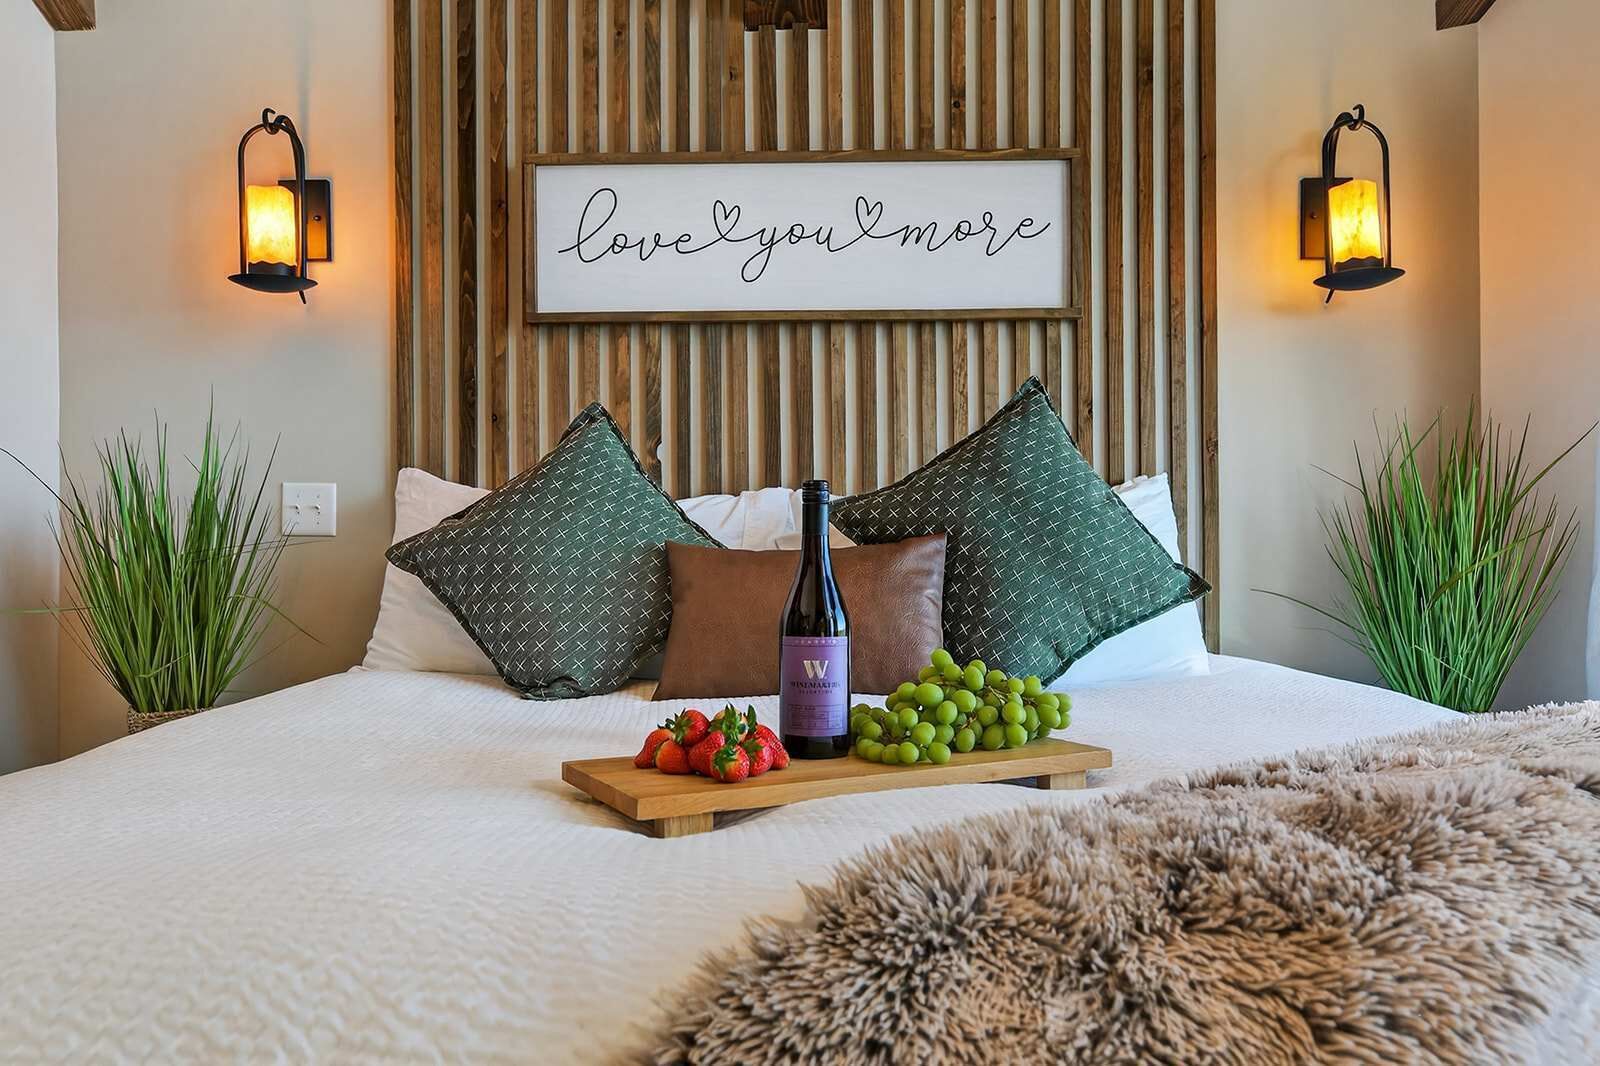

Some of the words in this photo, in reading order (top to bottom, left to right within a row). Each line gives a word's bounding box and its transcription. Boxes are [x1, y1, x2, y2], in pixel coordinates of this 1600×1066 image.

[558, 187, 702, 264] love
[741, 222, 850, 284] you
[898, 210, 1052, 257] more
